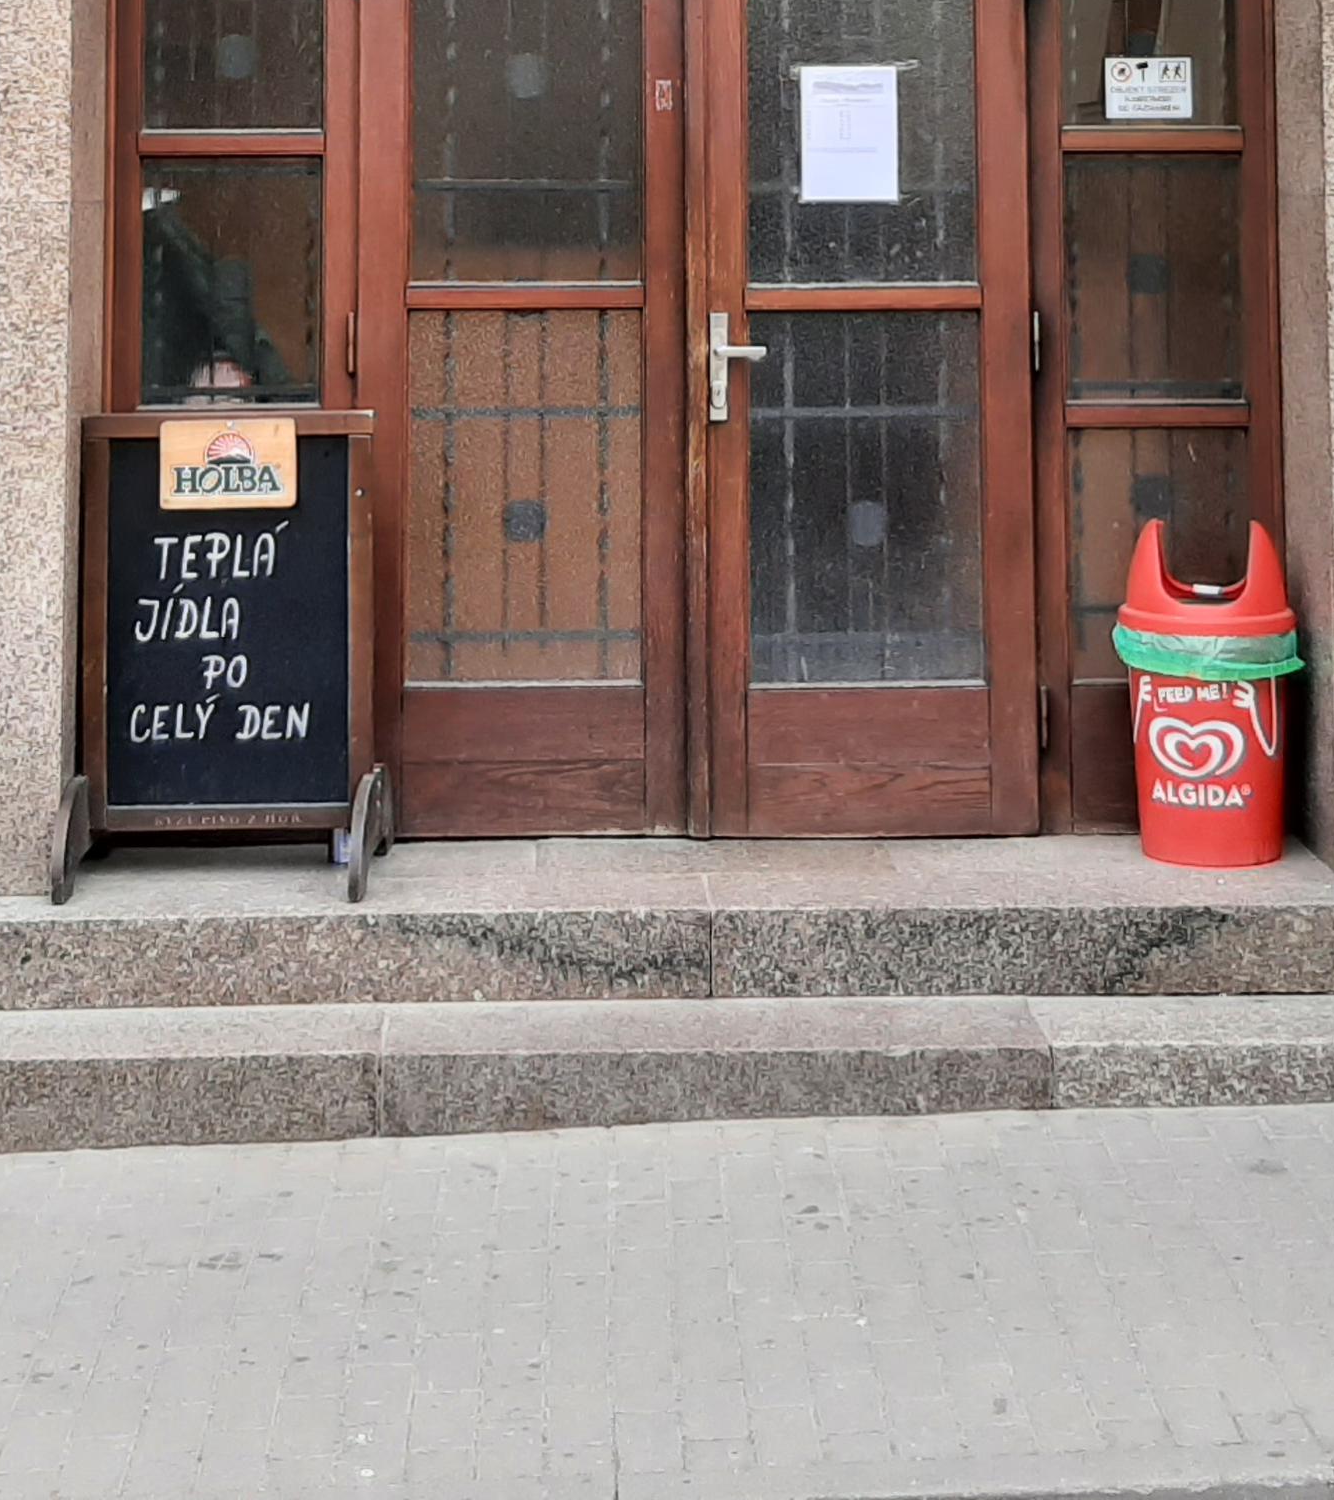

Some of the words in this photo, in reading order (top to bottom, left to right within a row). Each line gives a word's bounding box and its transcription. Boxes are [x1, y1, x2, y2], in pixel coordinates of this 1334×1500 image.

[172, 464, 282, 495] HOLBA
[153, 520, 289, 580] TEPLÁ
[134, 583, 240, 642] JÍDLA
[201, 654, 248, 690] PO
[130, 693, 219, 743] CELÝ
[235, 702, 310, 741] DEN
[1152, 778, 1244, 807] ALGIDA
